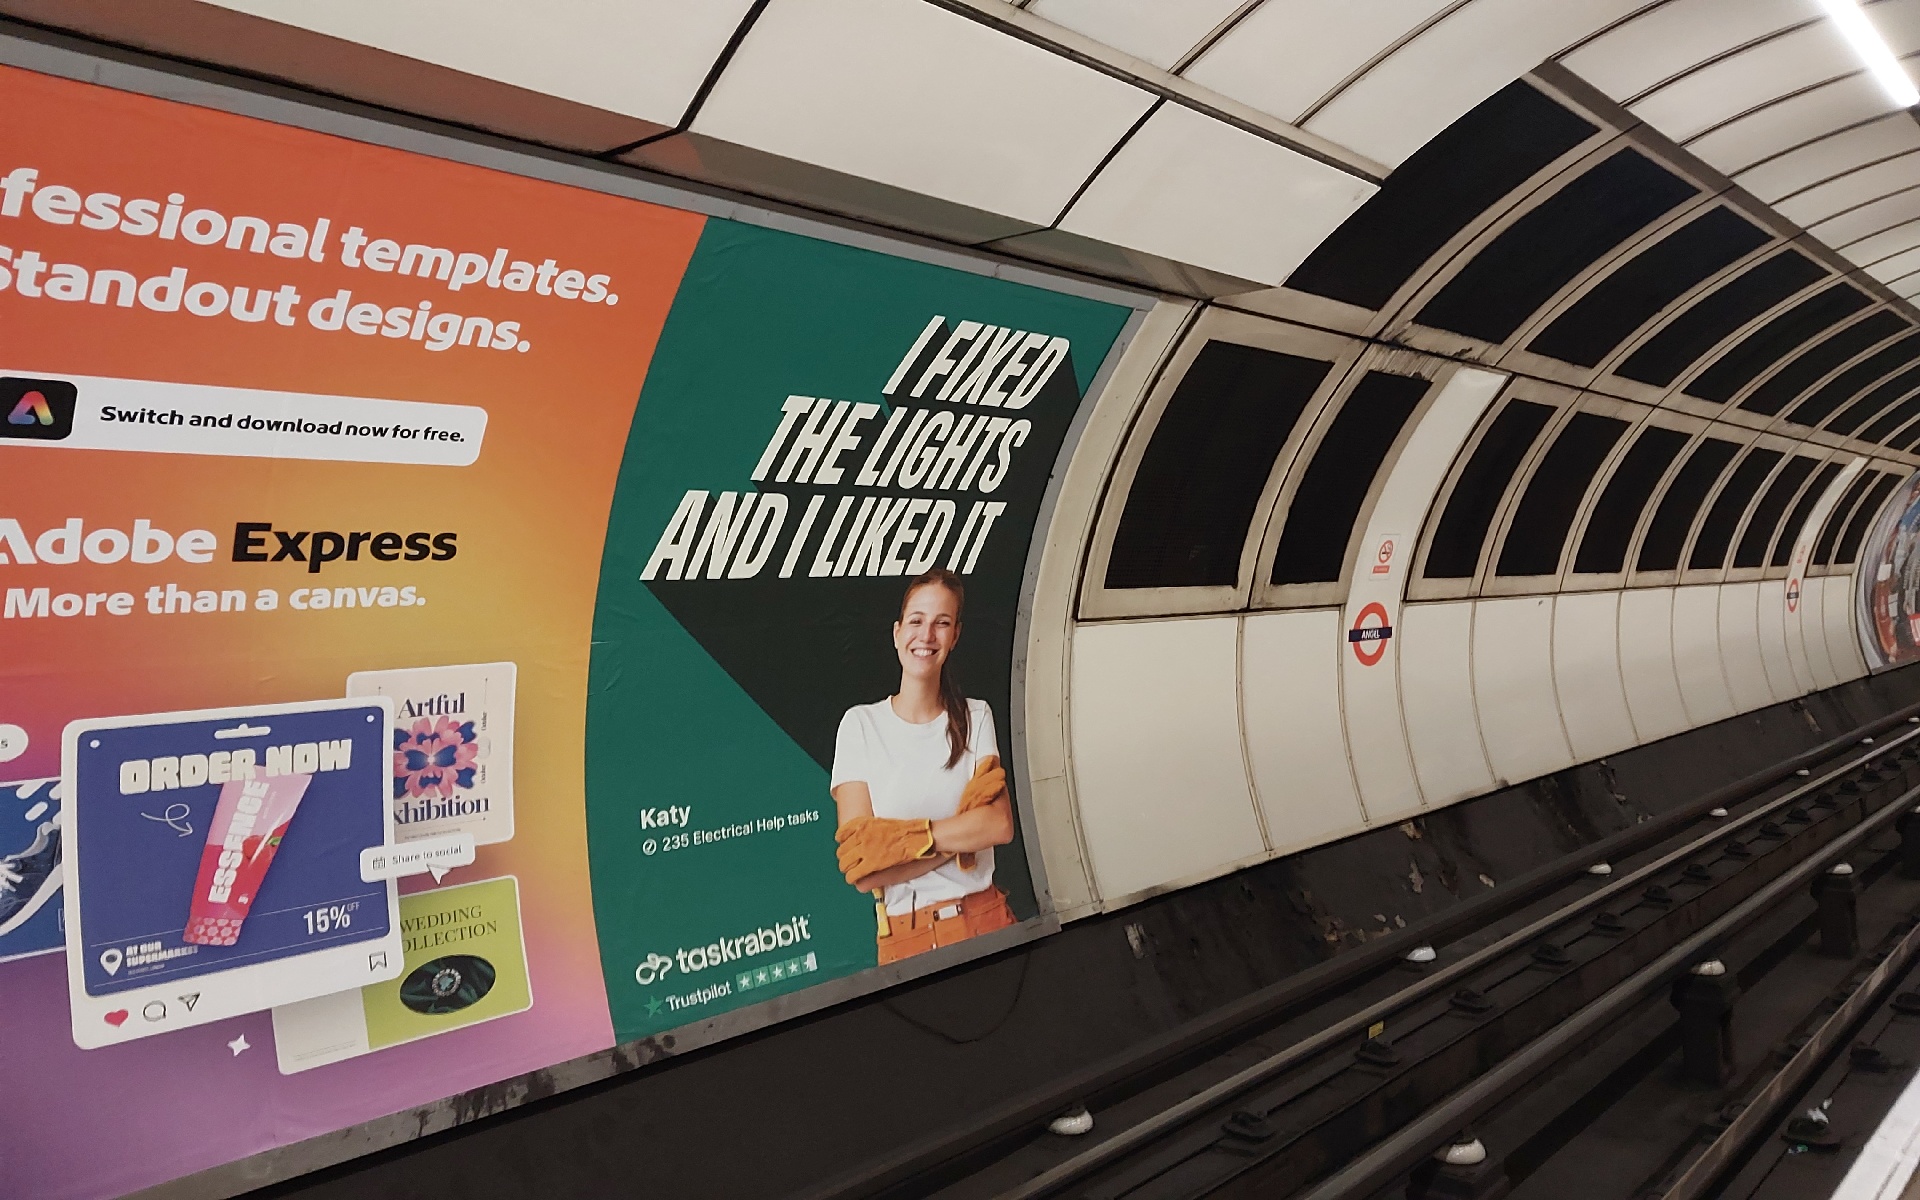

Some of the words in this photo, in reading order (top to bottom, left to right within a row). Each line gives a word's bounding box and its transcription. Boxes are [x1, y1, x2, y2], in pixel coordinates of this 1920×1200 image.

[0, 168, 330, 262] fessional
[340, 226, 619, 305] templates.
[307, 290, 530, 352] designs.
[881, 315, 945, 396] I
[918, 320, 1070, 410] FIXED
[100, 405, 184, 426] Switch
[189, 413, 233, 430] and
[237, 415, 342, 436] download
[344, 425, 389, 438] now
[392, 424, 420, 441] for
[423, 426, 465, 443] free.
[750, 394, 880, 485] THE
[855, 407, 1032, 493] LIGHTS
[0, 518, 217, 565] Adobe
[231, 522, 457, 573] Express
[639, 489, 789, 581] AND
[778, 494, 826, 579] I
[808, 496, 956, 578] LIKED
[948, 501, 1007, 575] IT
[3, 587, 134, 618] More
[145, 583, 247, 615] than
[255, 588, 278, 610] a
[289, 585, 426, 610] canvas.
[1361, 629, 1380, 640] ANGEL
[396, 692, 465, 719] Artful
[119, 748, 256, 795] ORDER
[265, 738, 352, 777] NOW
[640, 805, 691, 829] Katy
[662, 833, 689, 852] 235
[693, 821, 753, 846] Electrical
[756, 815, 785, 833] Help
[787, 809, 819, 826] tasks
[208, 779, 270, 903] ESSENCE
[392, 853, 420, 865] Share
[423, 850, 433, 859] to
[435, 845, 462, 857] social
[303, 904, 350, 935] 15%
[400, 905, 482, 933] WEDDING
[675, 915, 811, 974] taskrabbit
[666, 981, 732, 1011] Trustpilot
